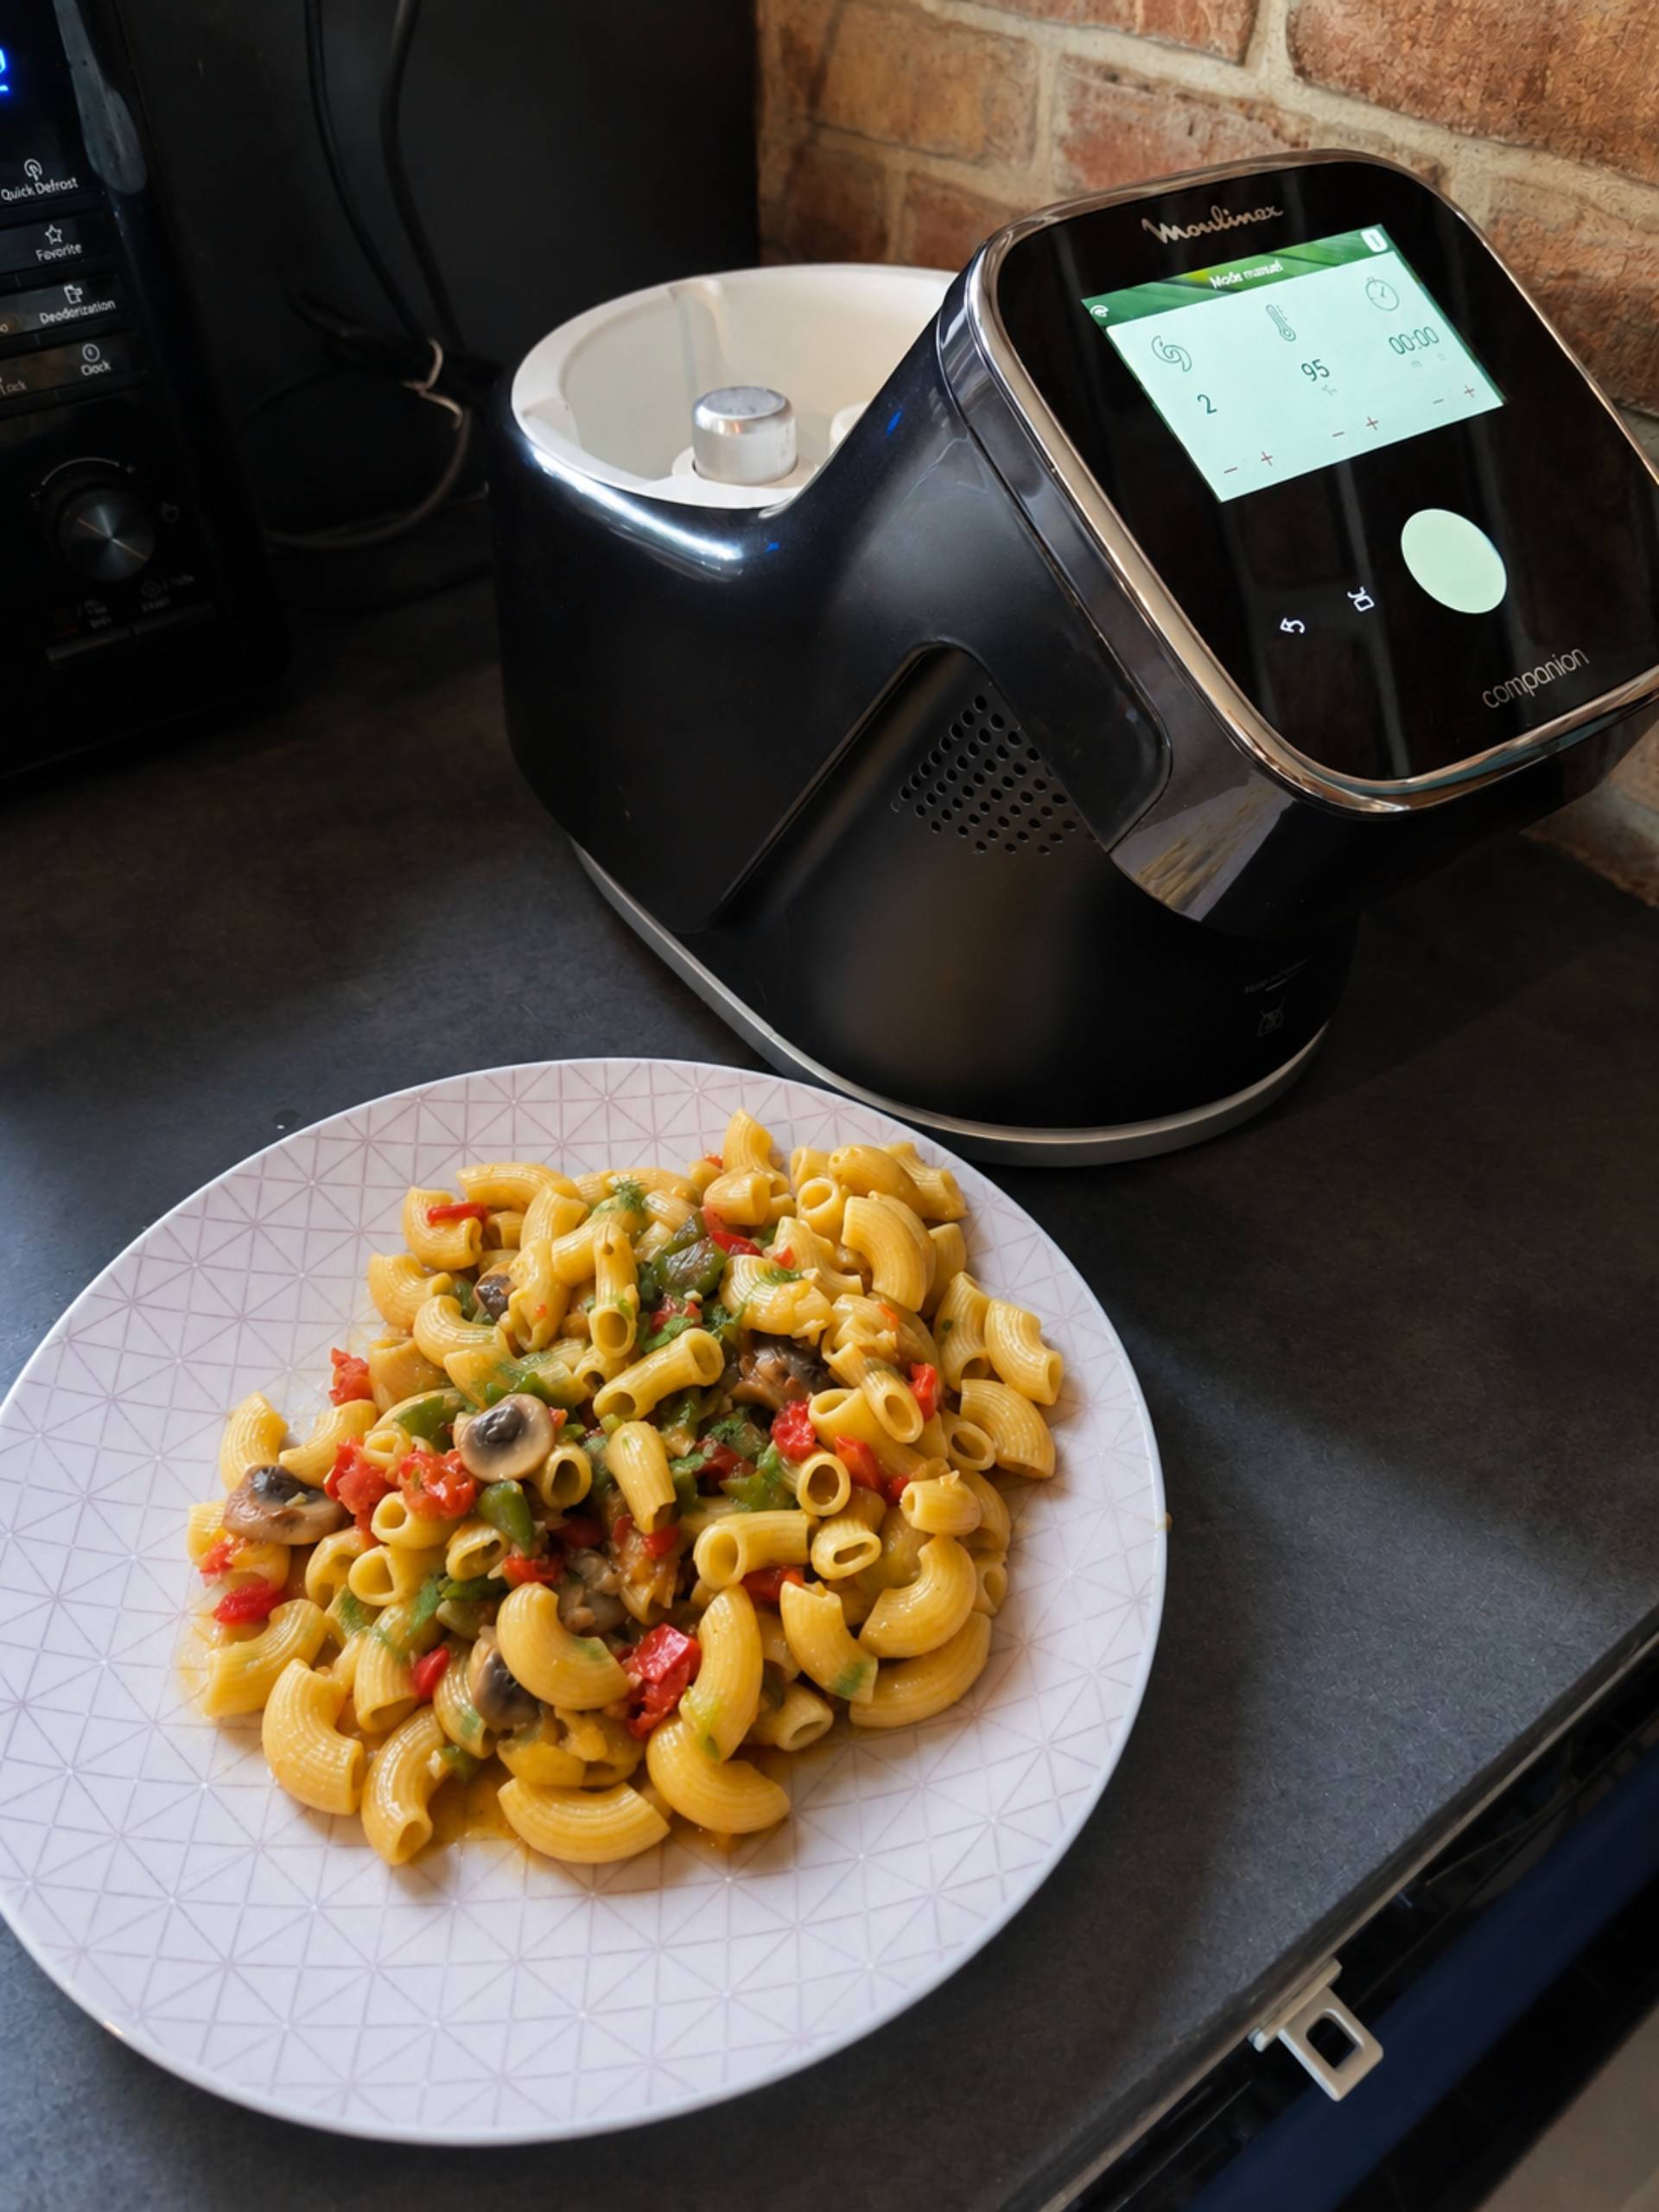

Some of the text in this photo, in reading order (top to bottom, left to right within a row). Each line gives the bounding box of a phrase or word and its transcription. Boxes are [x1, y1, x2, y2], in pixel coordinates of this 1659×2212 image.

[1, 176, 79, 201] Quick Defrost
[1141, 205, 1284, 244] Moulinex
[35, 242, 83, 262] Favorite
[1209, 271, 1243, 289] Mode
[40, 300, 117, 325] Deodorization
[1388, 326, 1440, 355] 00:00
[80, 361, 112, 378] Clock
[1300, 359, 1331, 382] 95
[1197, 392, 1217, 415] 2
[1482, 647, 1590, 709] companion
